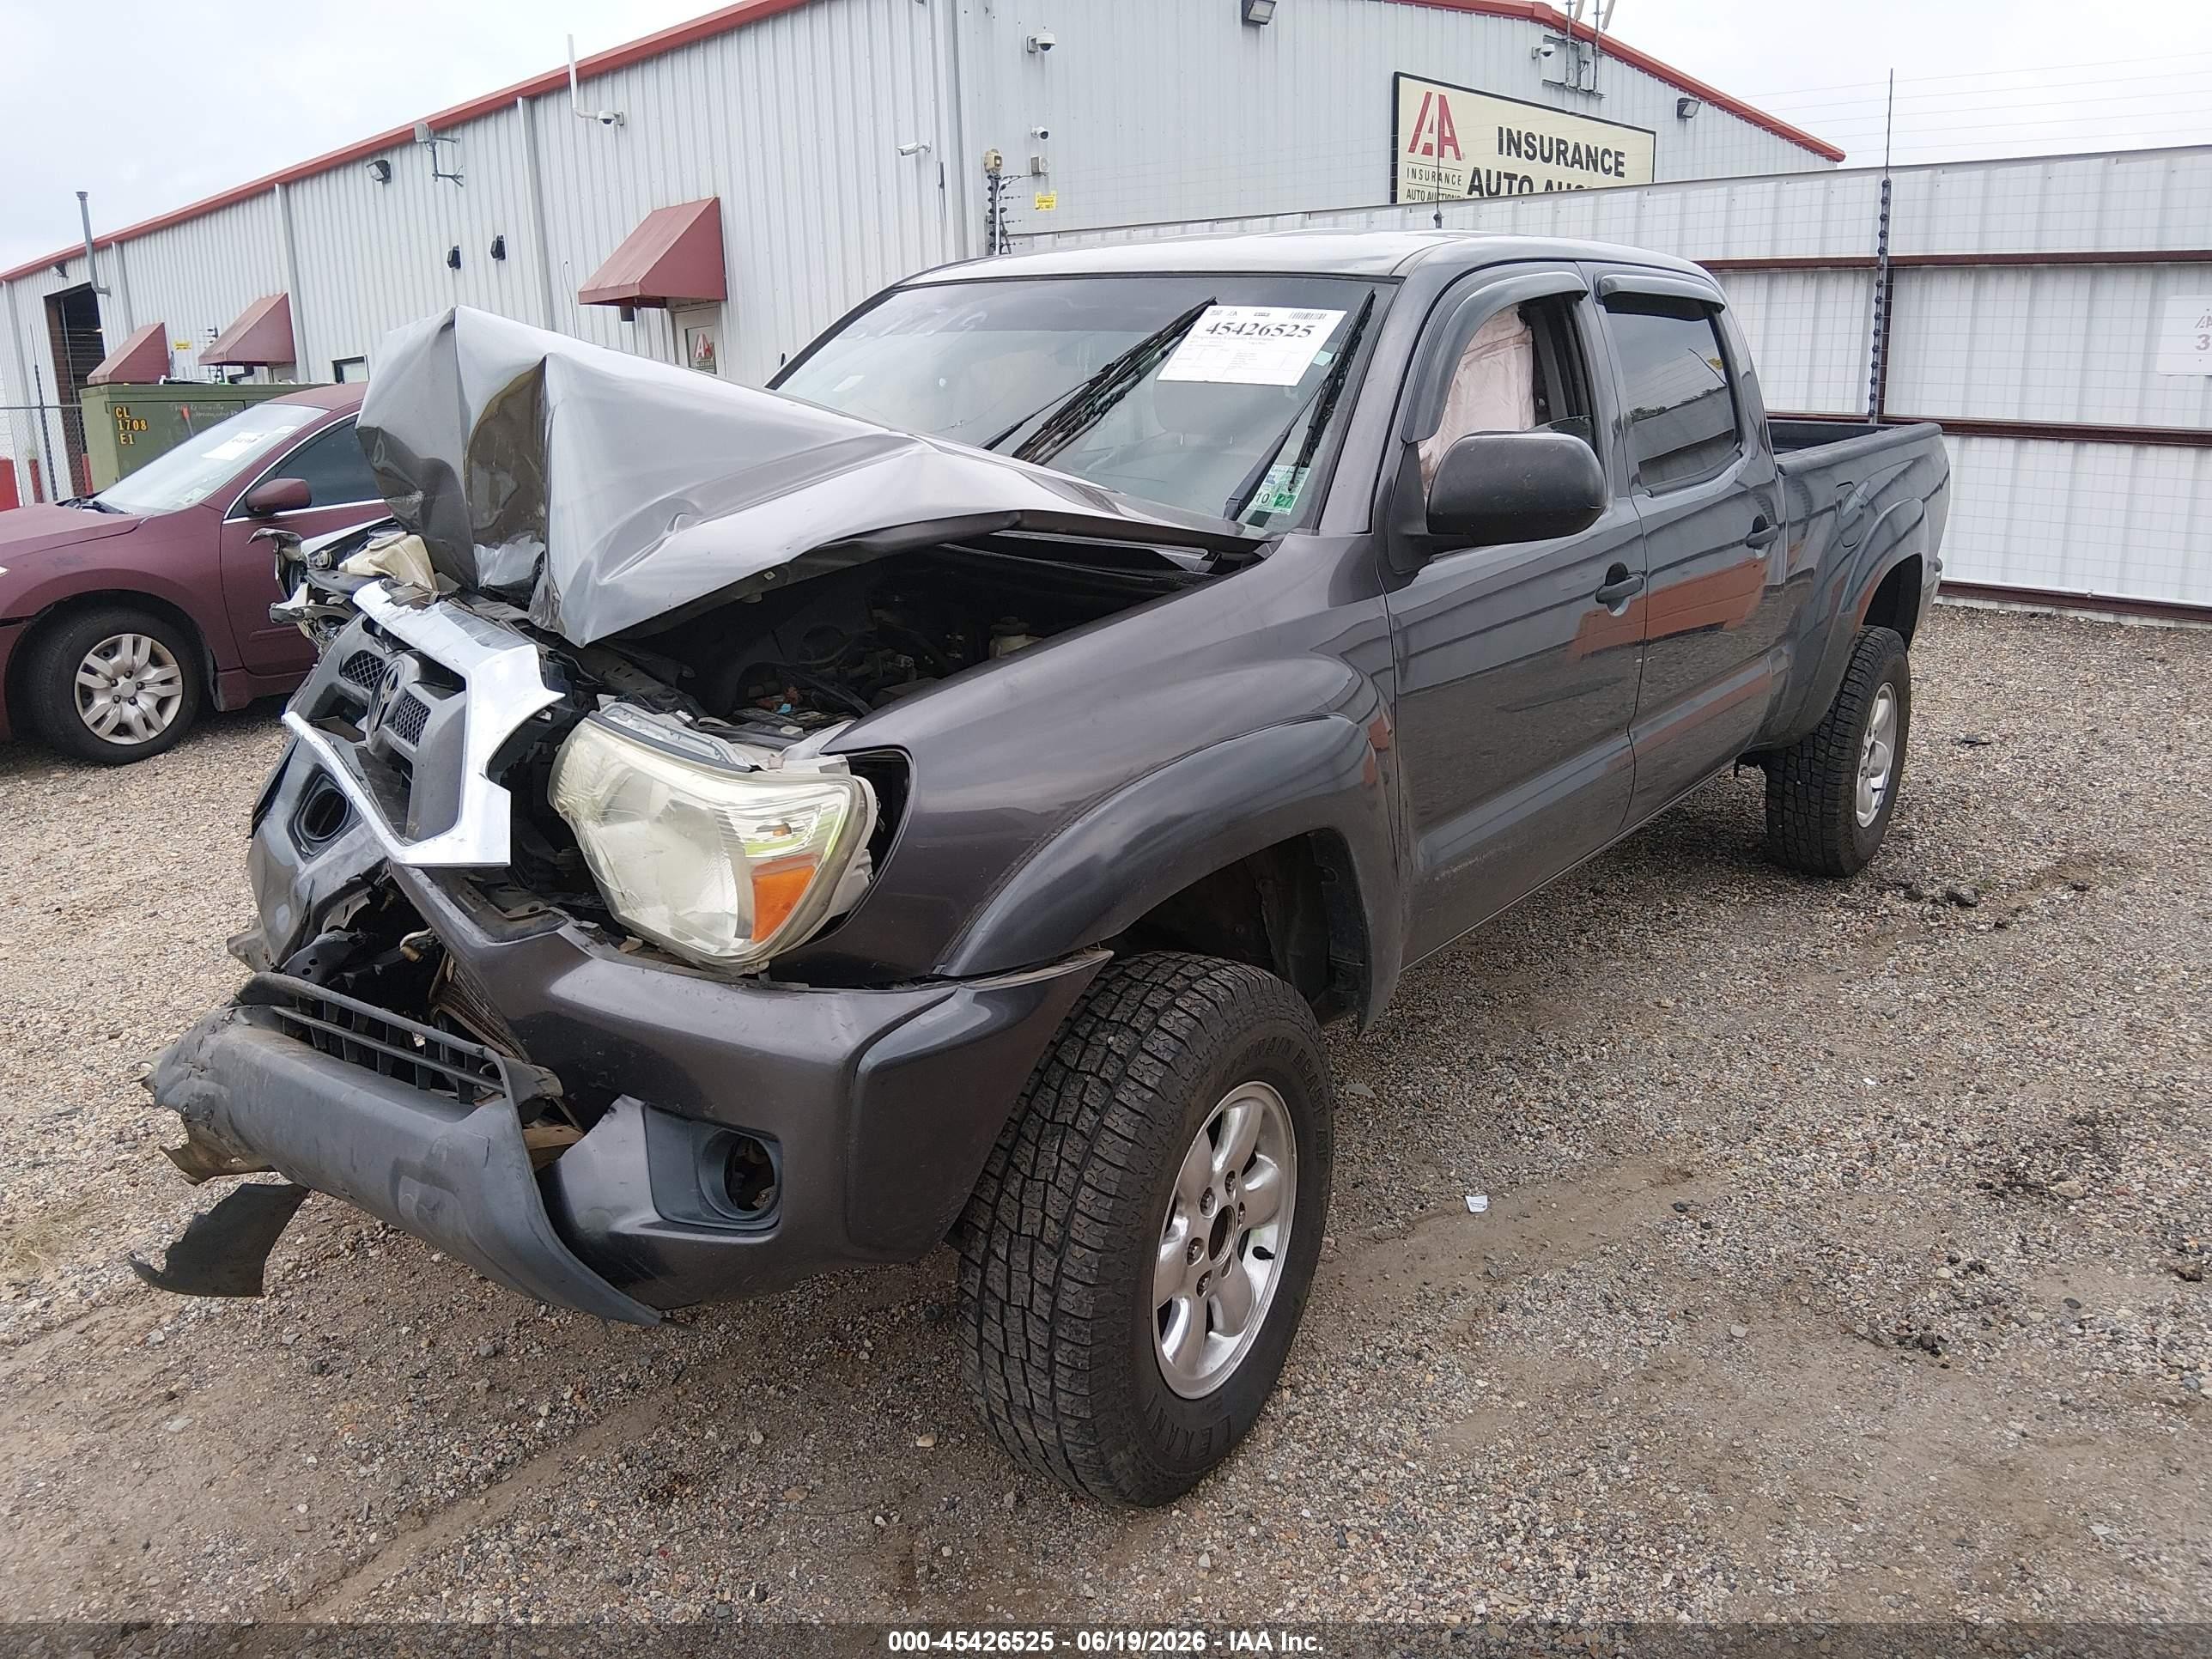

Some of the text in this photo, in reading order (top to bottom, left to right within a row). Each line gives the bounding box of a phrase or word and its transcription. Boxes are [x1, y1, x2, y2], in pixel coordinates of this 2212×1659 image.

[1498, 126, 1626, 179] INSURANCE
[1407, 167, 1462, 185] INSURANCE
[1467, 167, 1534, 197] AUTO
[1407, 188, 1425, 202] AUTO
[1205, 322, 1316, 338] 45426525
[115, 407, 131, 418] CL
[118, 419, 148, 430] 1708
[120, 434, 135, 445] E1
[1255, 491, 1295, 507] 10 27
[1291, 1047, 1327, 1116] BEAST
